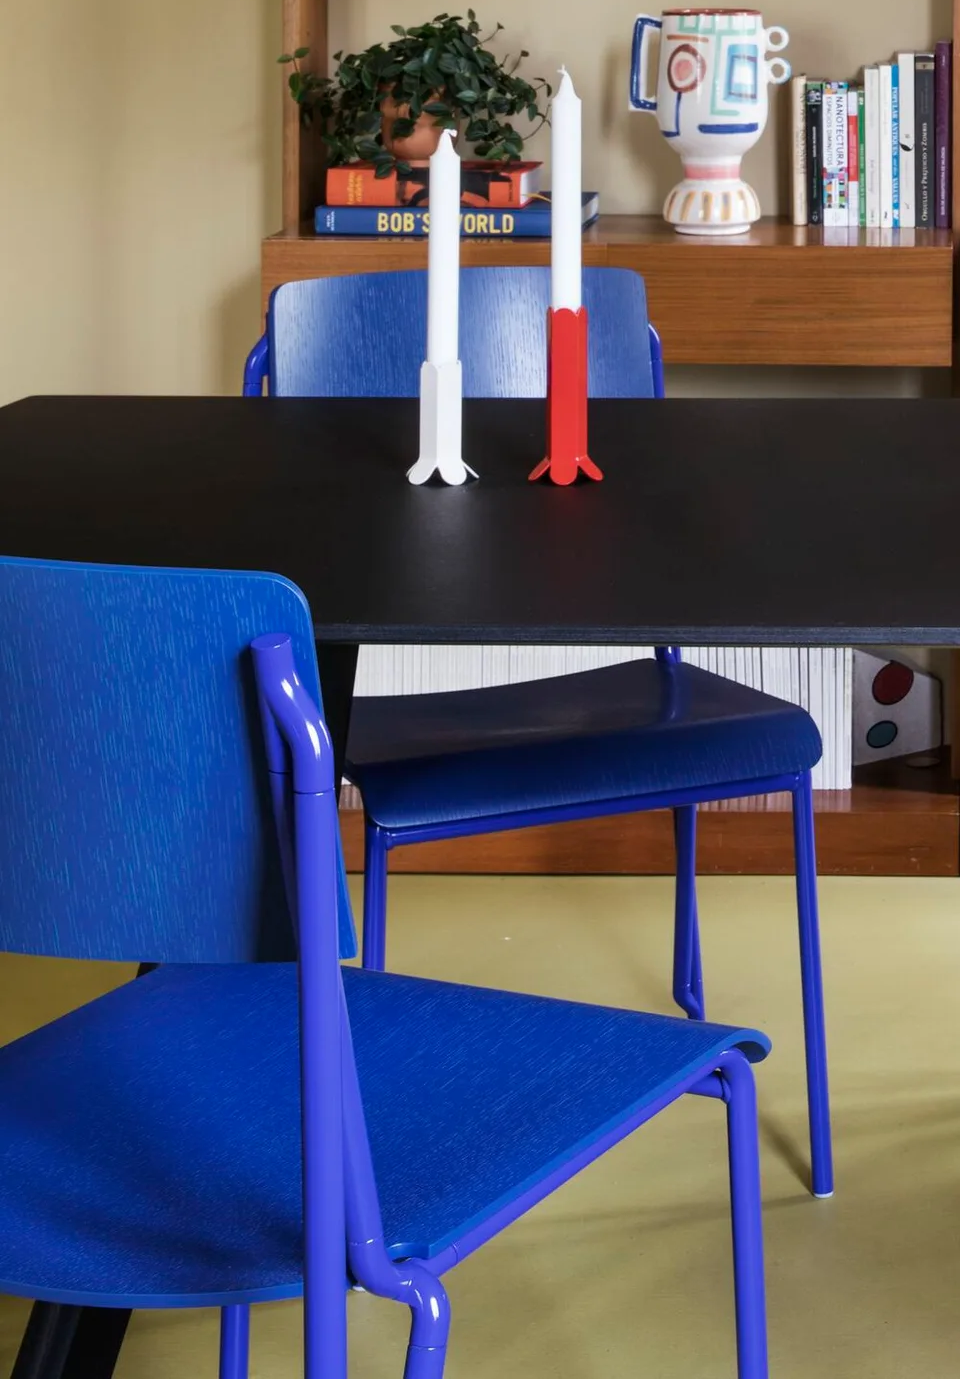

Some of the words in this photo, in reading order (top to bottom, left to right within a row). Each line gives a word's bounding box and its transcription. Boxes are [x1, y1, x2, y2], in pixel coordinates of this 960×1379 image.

[836, 96, 844, 166] NANOTECTURA
[920, 123, 928, 147] ZOMBIS
[920, 153, 928, 185] PREJUICIO
[920, 191, 928, 222] ORGULLO
[459, 214, 514, 233] ORLD
